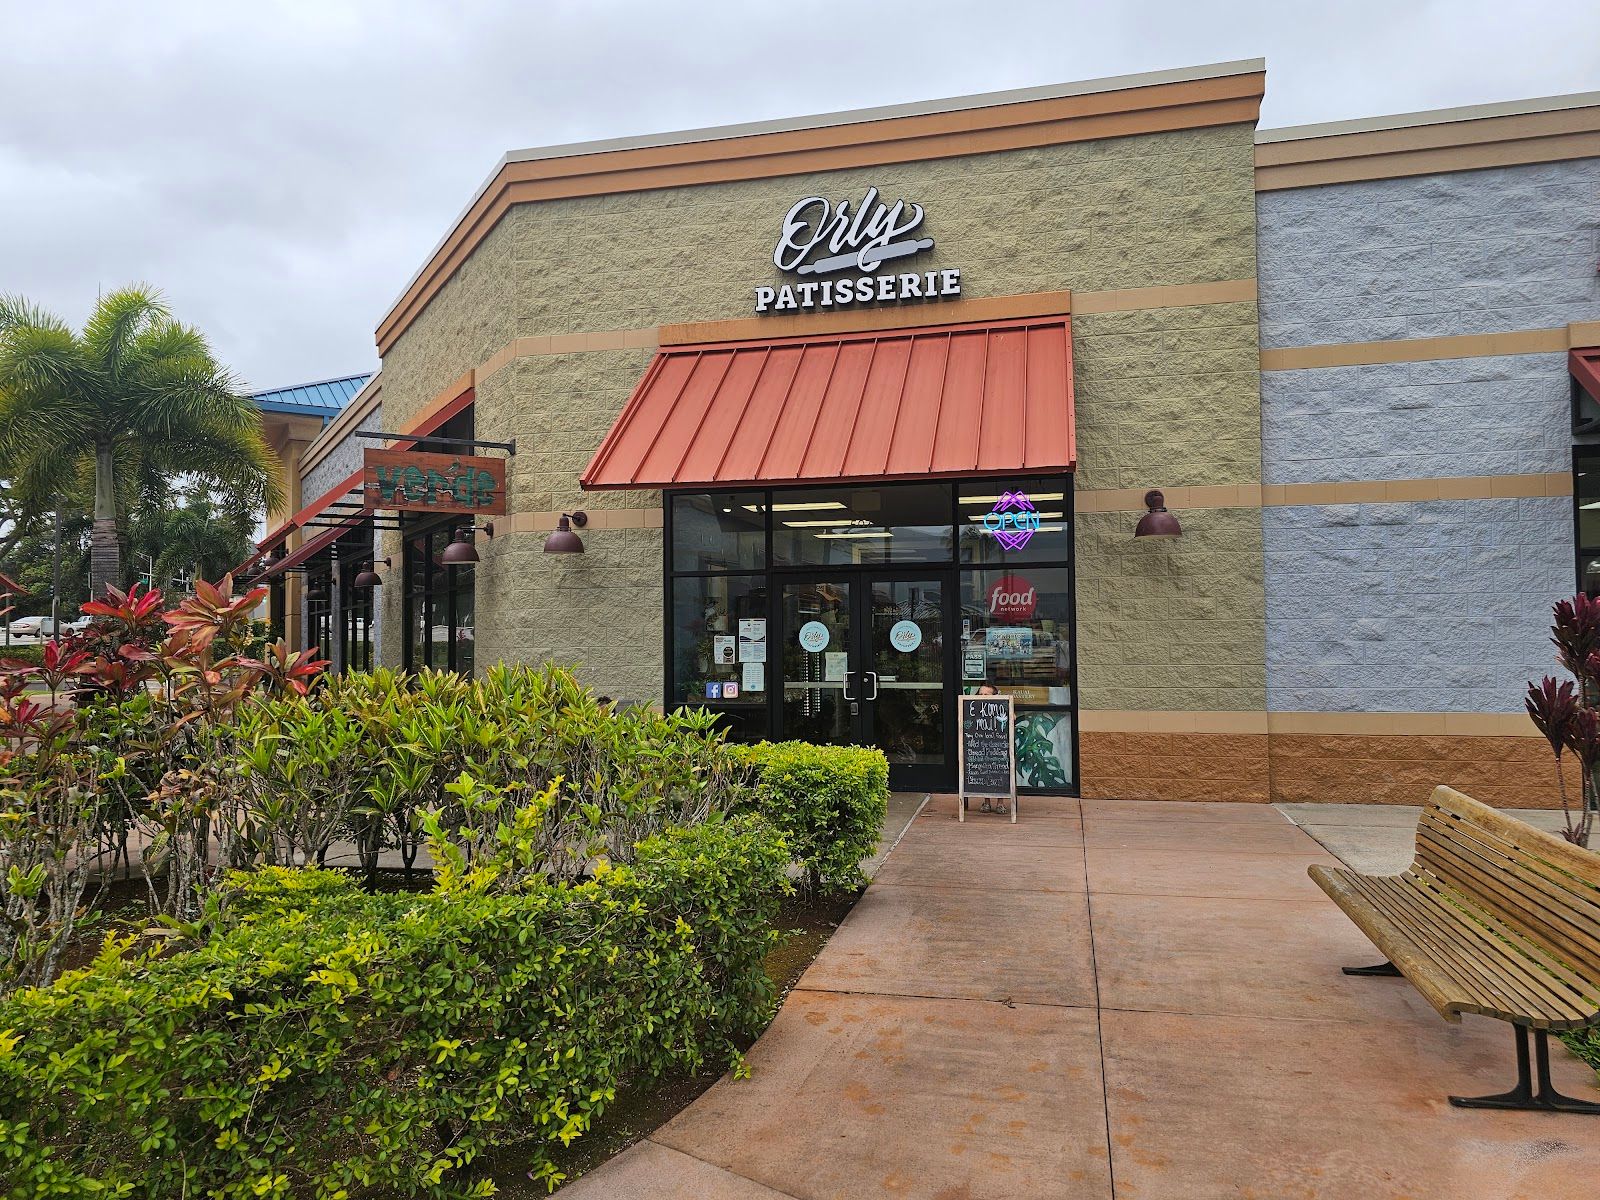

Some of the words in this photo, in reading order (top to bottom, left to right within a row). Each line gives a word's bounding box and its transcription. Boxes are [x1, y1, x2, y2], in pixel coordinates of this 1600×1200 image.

[773, 186, 925, 272] Orly
[755, 268, 962, 312] PATISSERIE
[376, 464, 497, 508] verde
[984, 511, 1040, 531] OPEN
[990, 586, 1035, 613] food
